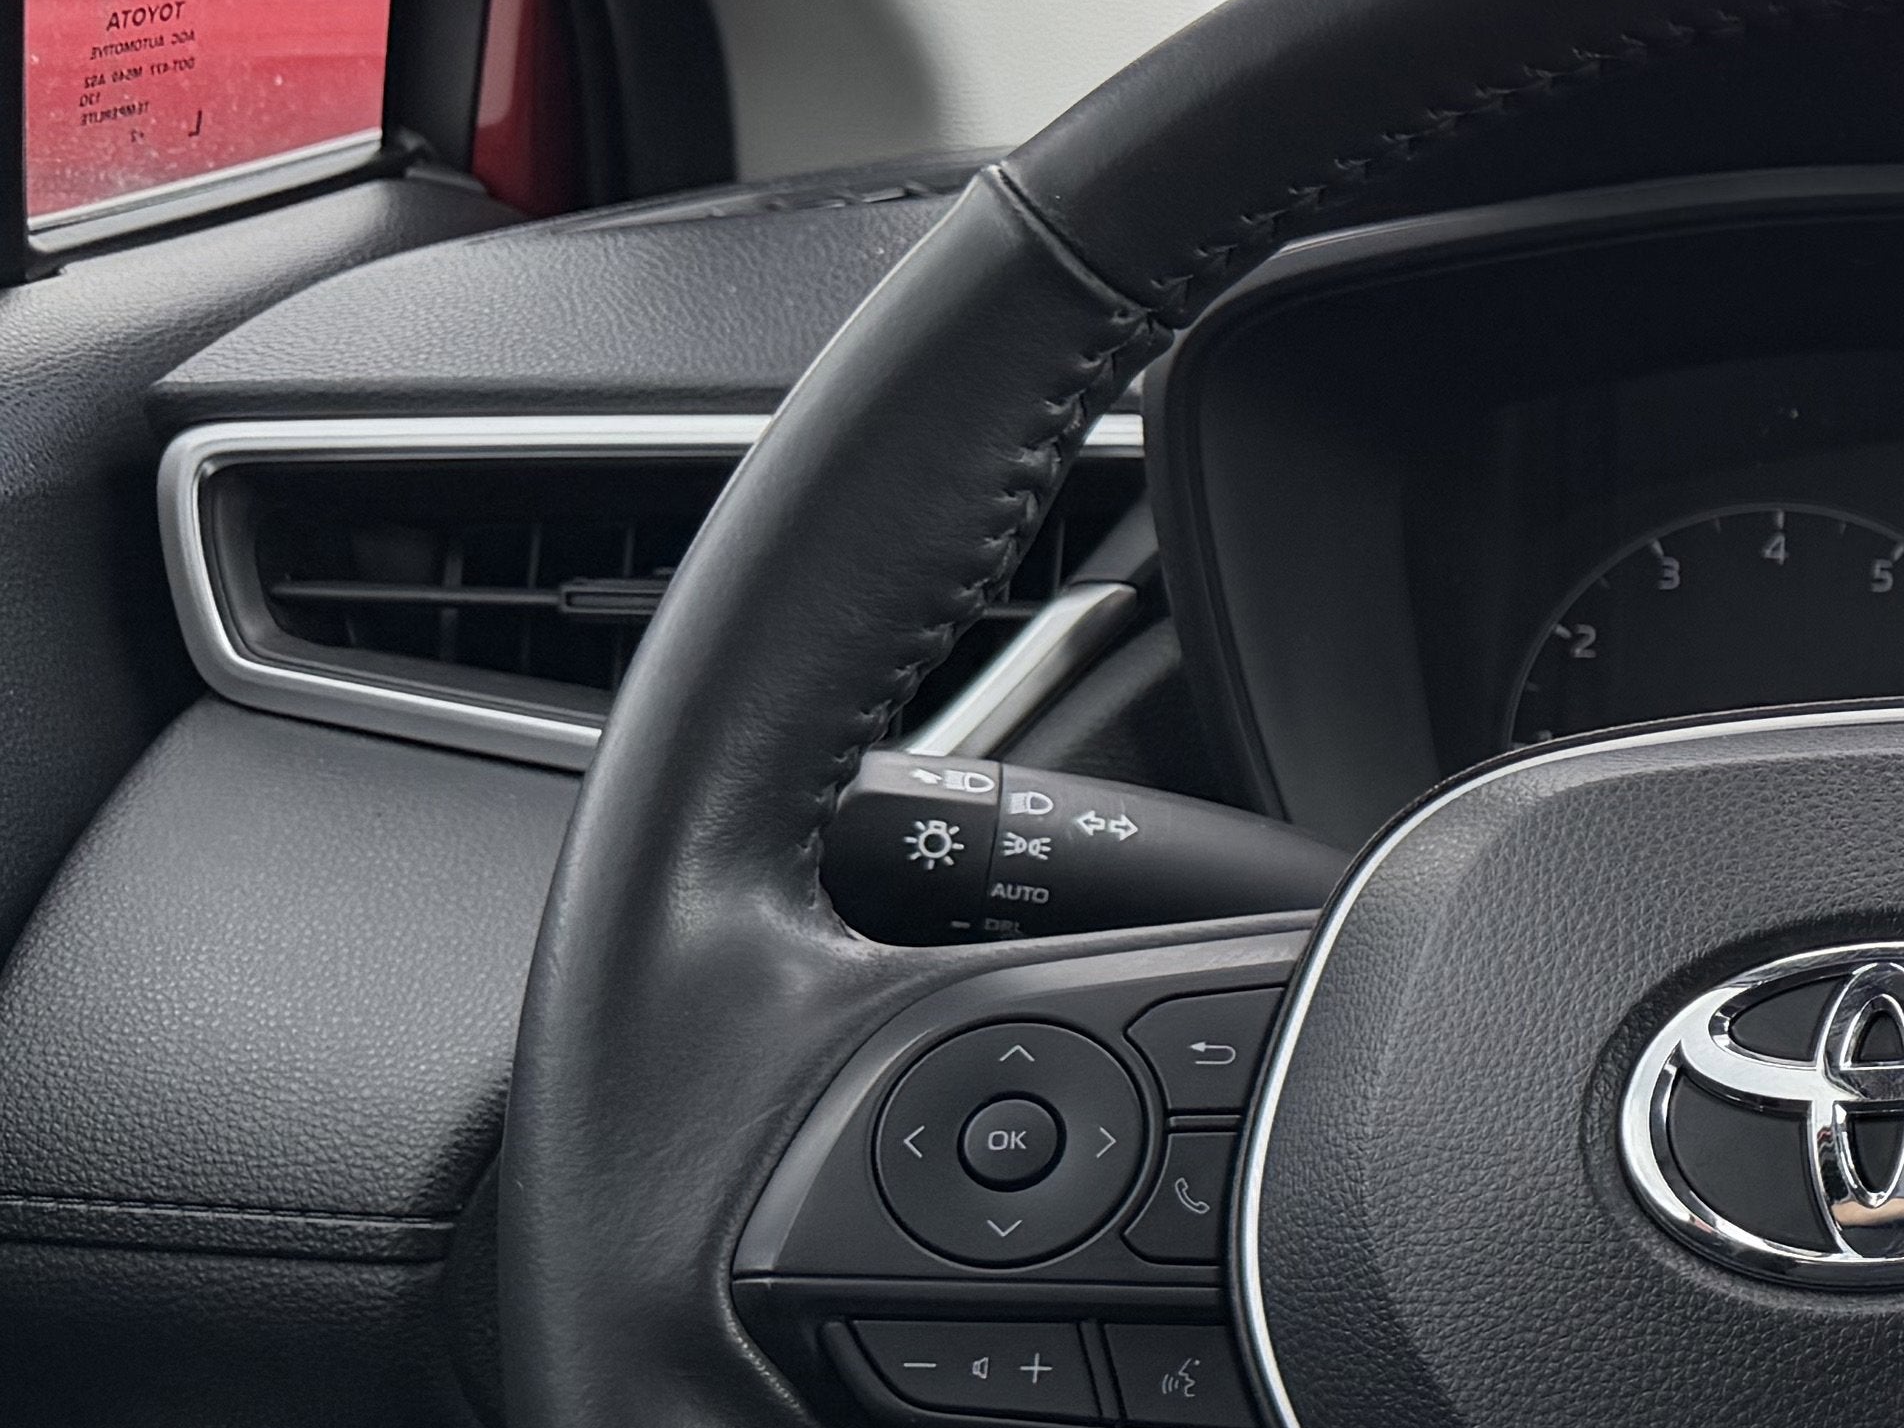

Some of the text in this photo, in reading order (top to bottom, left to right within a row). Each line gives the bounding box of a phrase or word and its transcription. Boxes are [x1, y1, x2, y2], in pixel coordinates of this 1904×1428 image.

[1761, 532, 1790, 566] 4
[1656, 557, 1681, 590] 3
[1870, 559, 1895, 593] 5
[1569, 623, 1597, 658] 2
[991, 881, 1050, 904] AUTO
[987, 1128, 1026, 1151] OK
